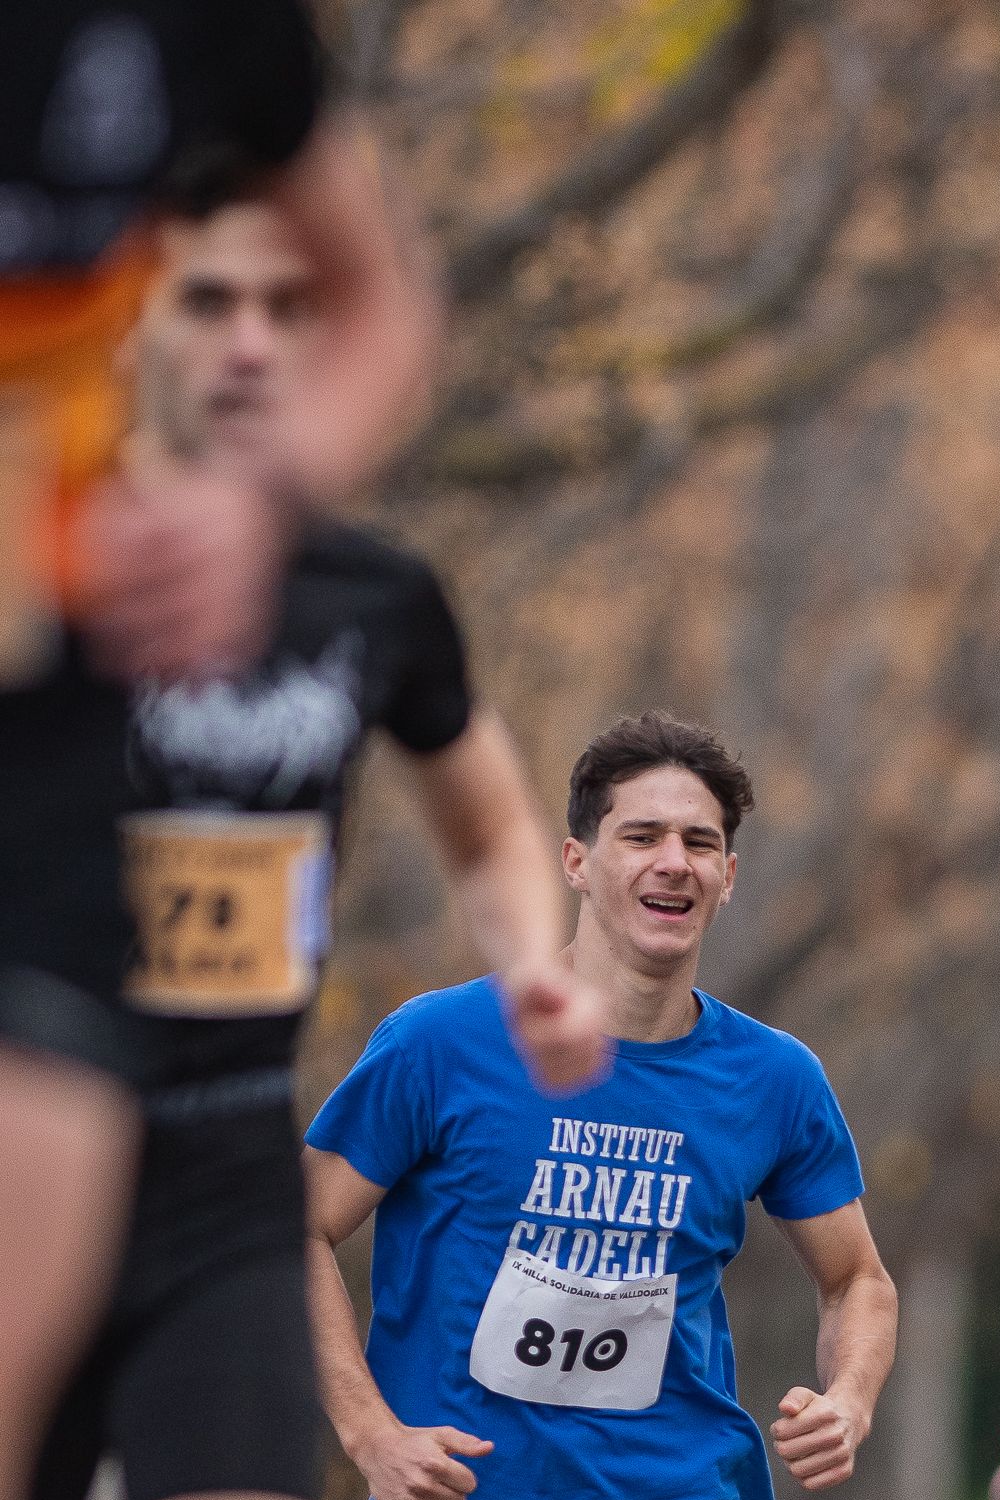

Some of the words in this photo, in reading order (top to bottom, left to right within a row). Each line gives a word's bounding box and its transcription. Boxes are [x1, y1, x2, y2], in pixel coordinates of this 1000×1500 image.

[549, 1117, 683, 1165] INSTITUT
[520, 1159, 692, 1229] ARNAU
[512, 1260, 522, 1270] IX
[522, 1267, 547, 1284] MILLA
[603, 1293, 617, 1301] DE
[619, 1287, 669, 1300] VALLDOREIX
[513, 1317, 628, 1373] 810
